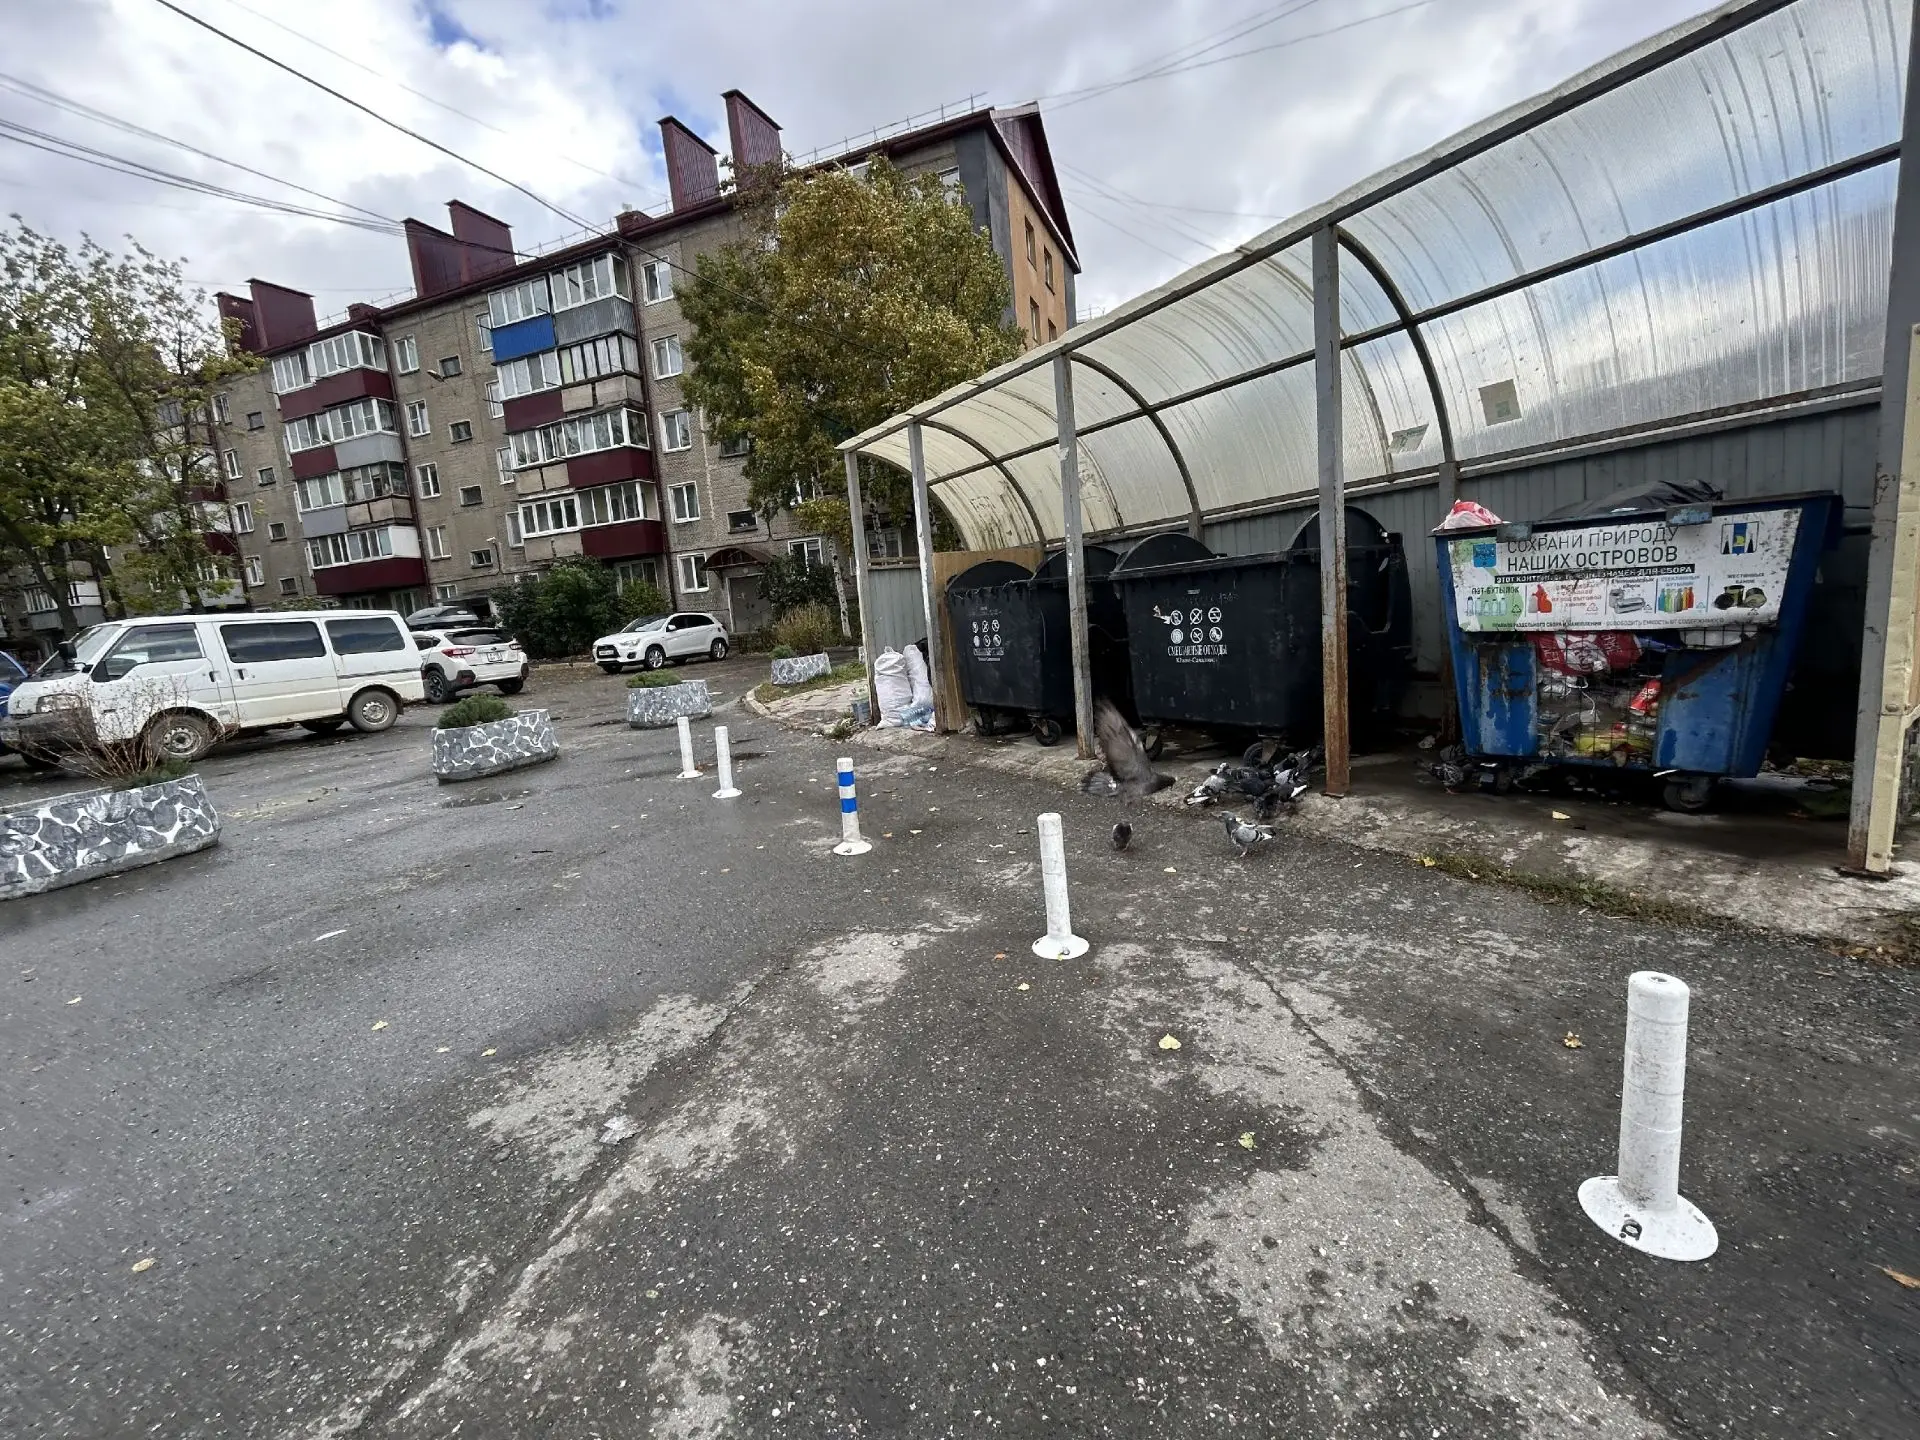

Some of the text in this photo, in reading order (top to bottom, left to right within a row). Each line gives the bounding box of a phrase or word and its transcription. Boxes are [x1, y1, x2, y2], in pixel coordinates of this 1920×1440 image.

[1507, 525, 1680, 554] СОХРАНИ ПРИРОДУ
[1508, 545, 1678, 572] НАШИХ ОСТРОВОВ
[1496, 575, 1514, 584] ЭТОТ
[1638, 566, 1657, 577] ДЛЯ
[1660, 565, 1692, 576] СБОРА
[1471, 586, 1520, 595] ПЭТ-БУТЫЛОК
